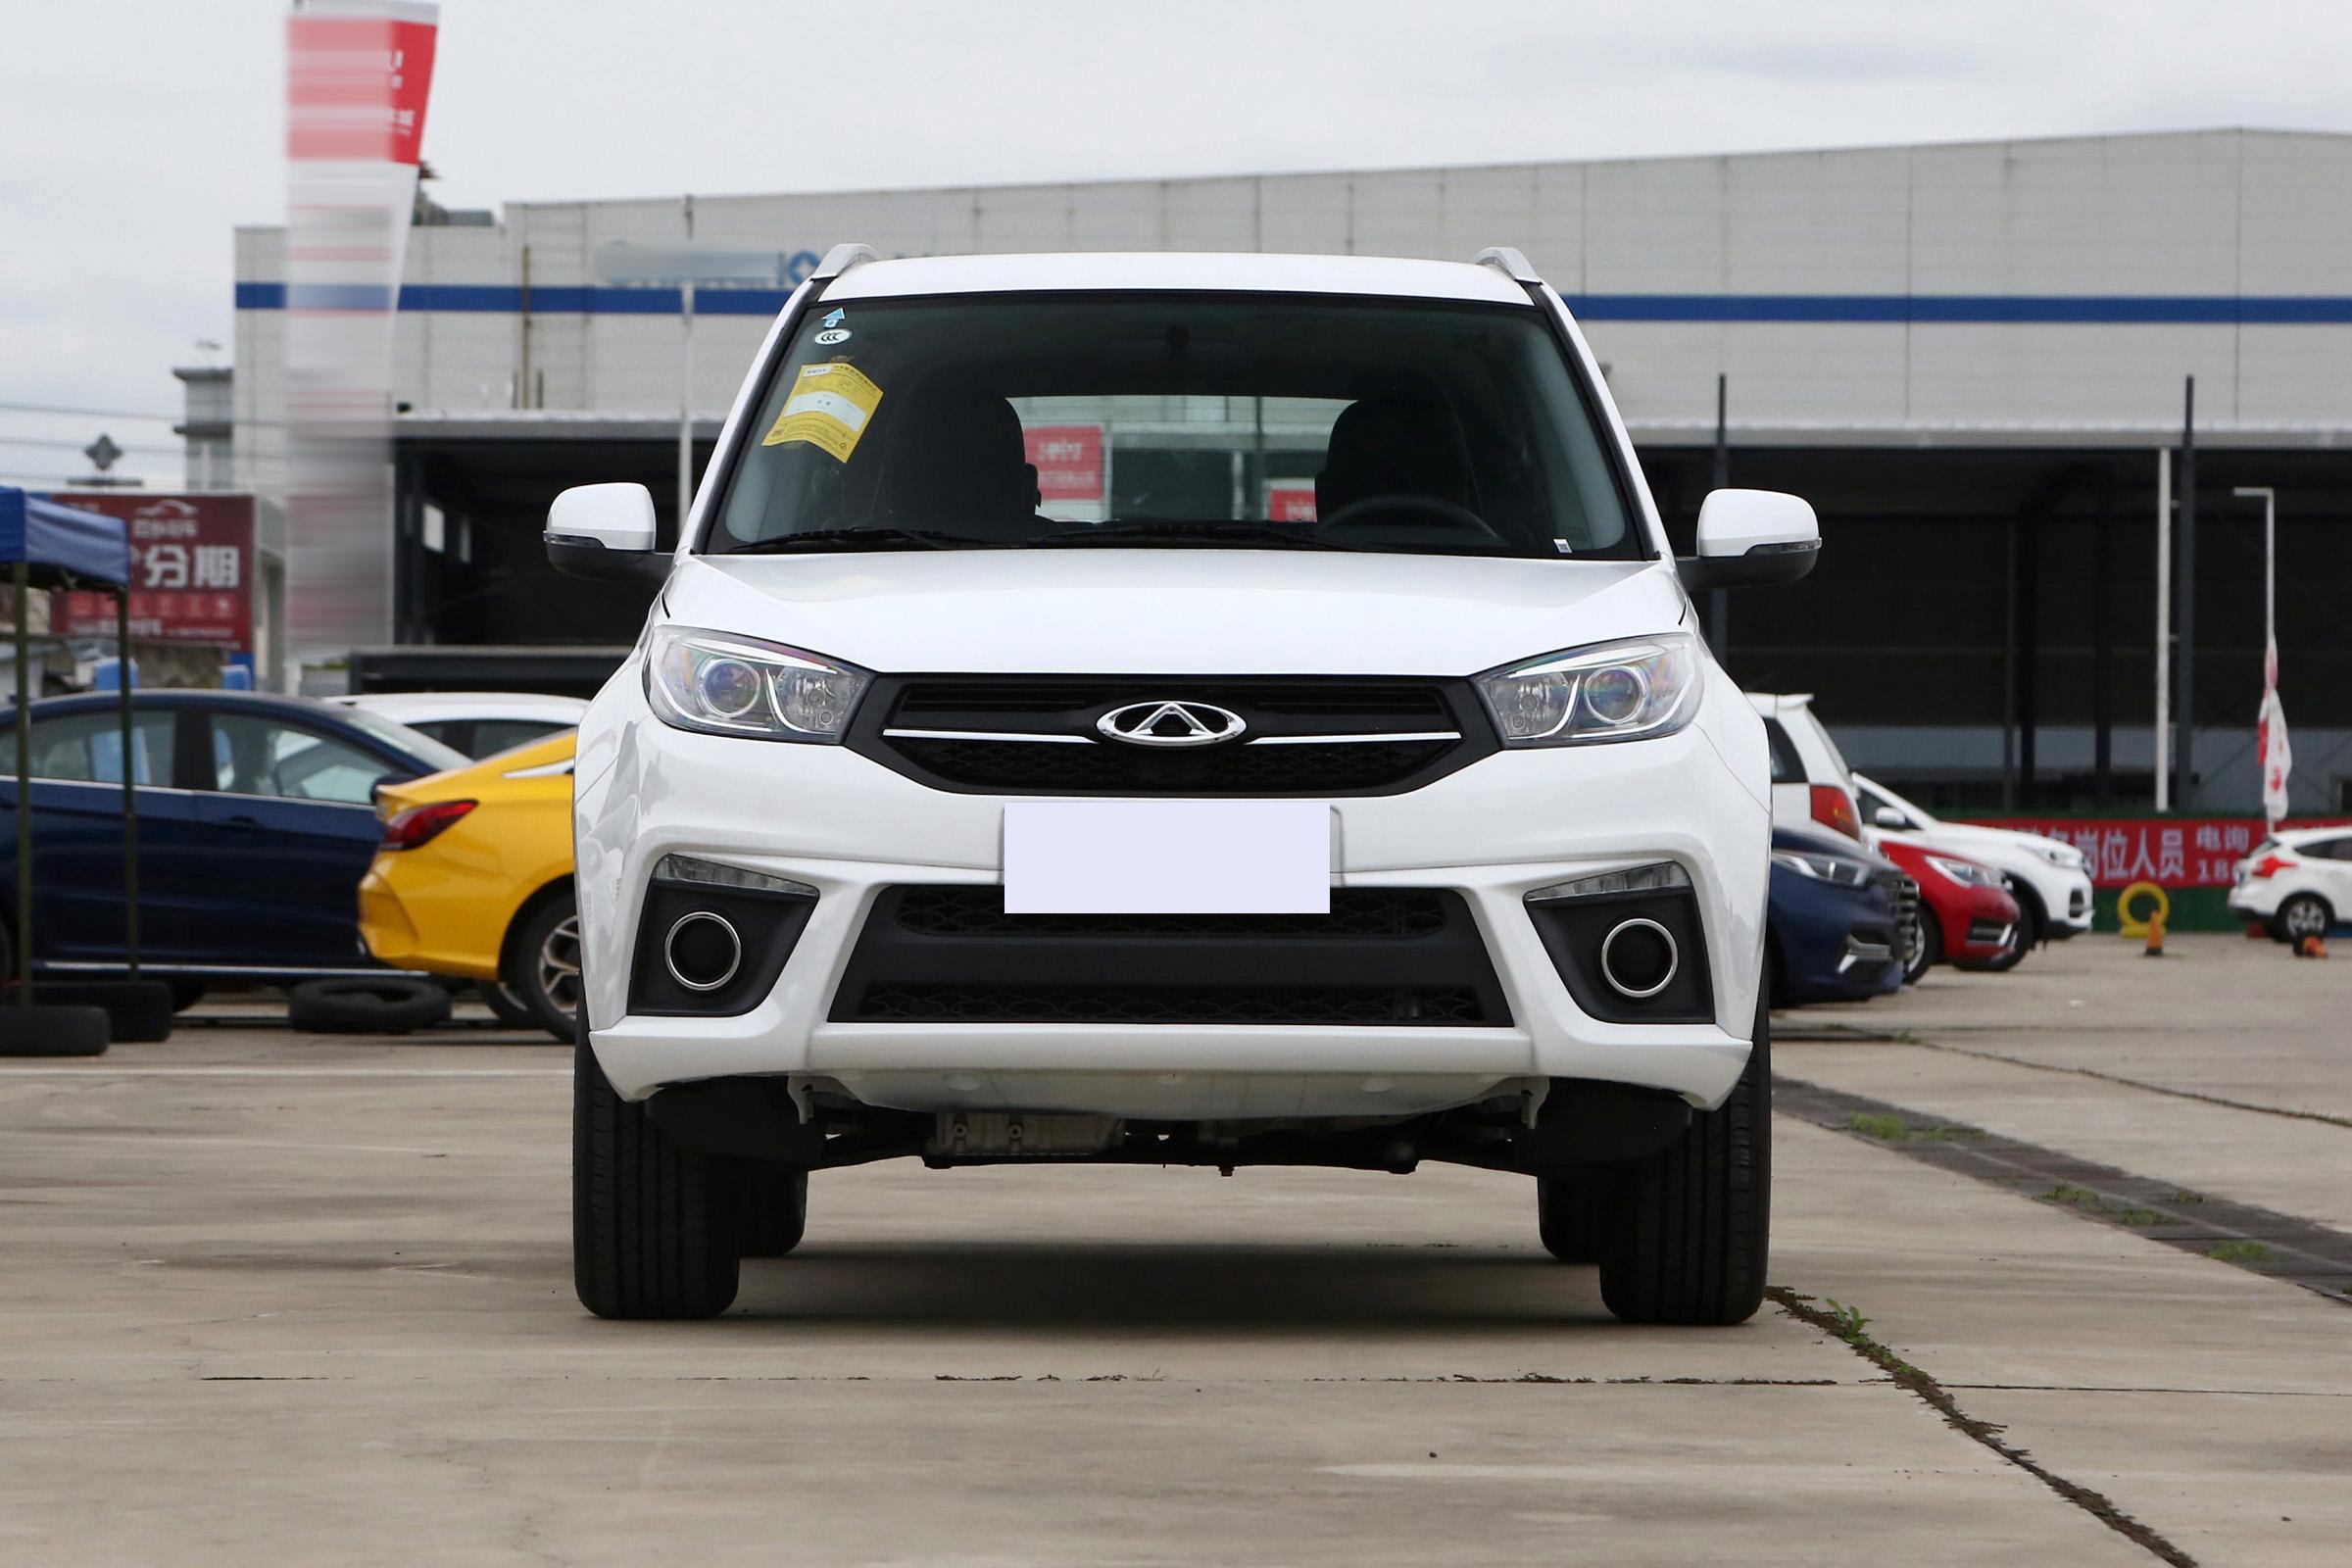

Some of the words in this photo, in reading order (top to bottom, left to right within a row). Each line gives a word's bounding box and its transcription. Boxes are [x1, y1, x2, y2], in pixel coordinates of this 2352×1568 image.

[144, 544, 239, 588] 分期
[2020, 825, 2183, 880] 岗位人员
